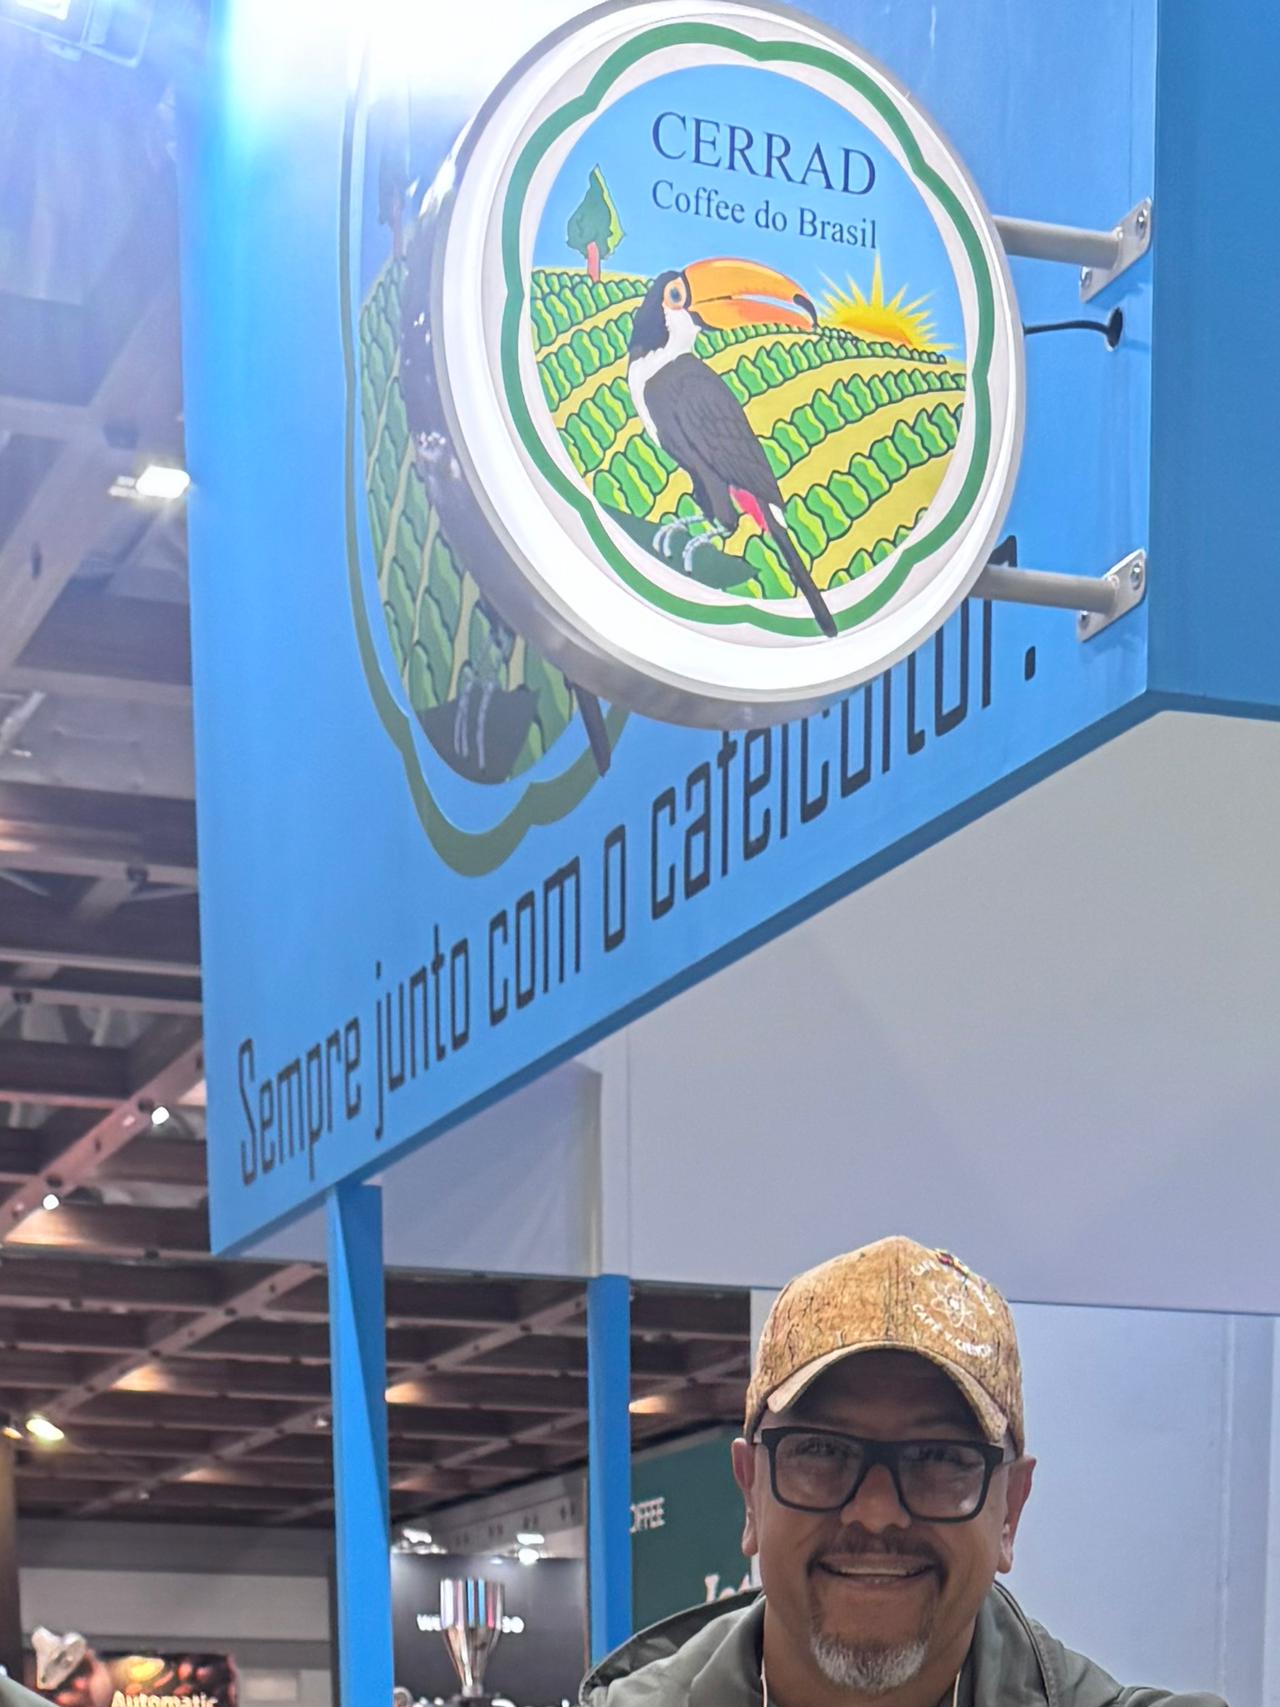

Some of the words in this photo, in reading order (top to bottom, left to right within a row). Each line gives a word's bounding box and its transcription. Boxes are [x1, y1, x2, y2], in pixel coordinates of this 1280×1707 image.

[650, 112, 878, 196] CERRAD
[651, 181, 746, 230] Coffee
[754, 195, 786, 231] do
[796, 207, 879, 250] Brasil
[239, 1016, 361, 1187] Sempre
[374, 923, 469, 1140] junto
[489, 858, 582, 1026] com
[603, 824, 627, 953] o
